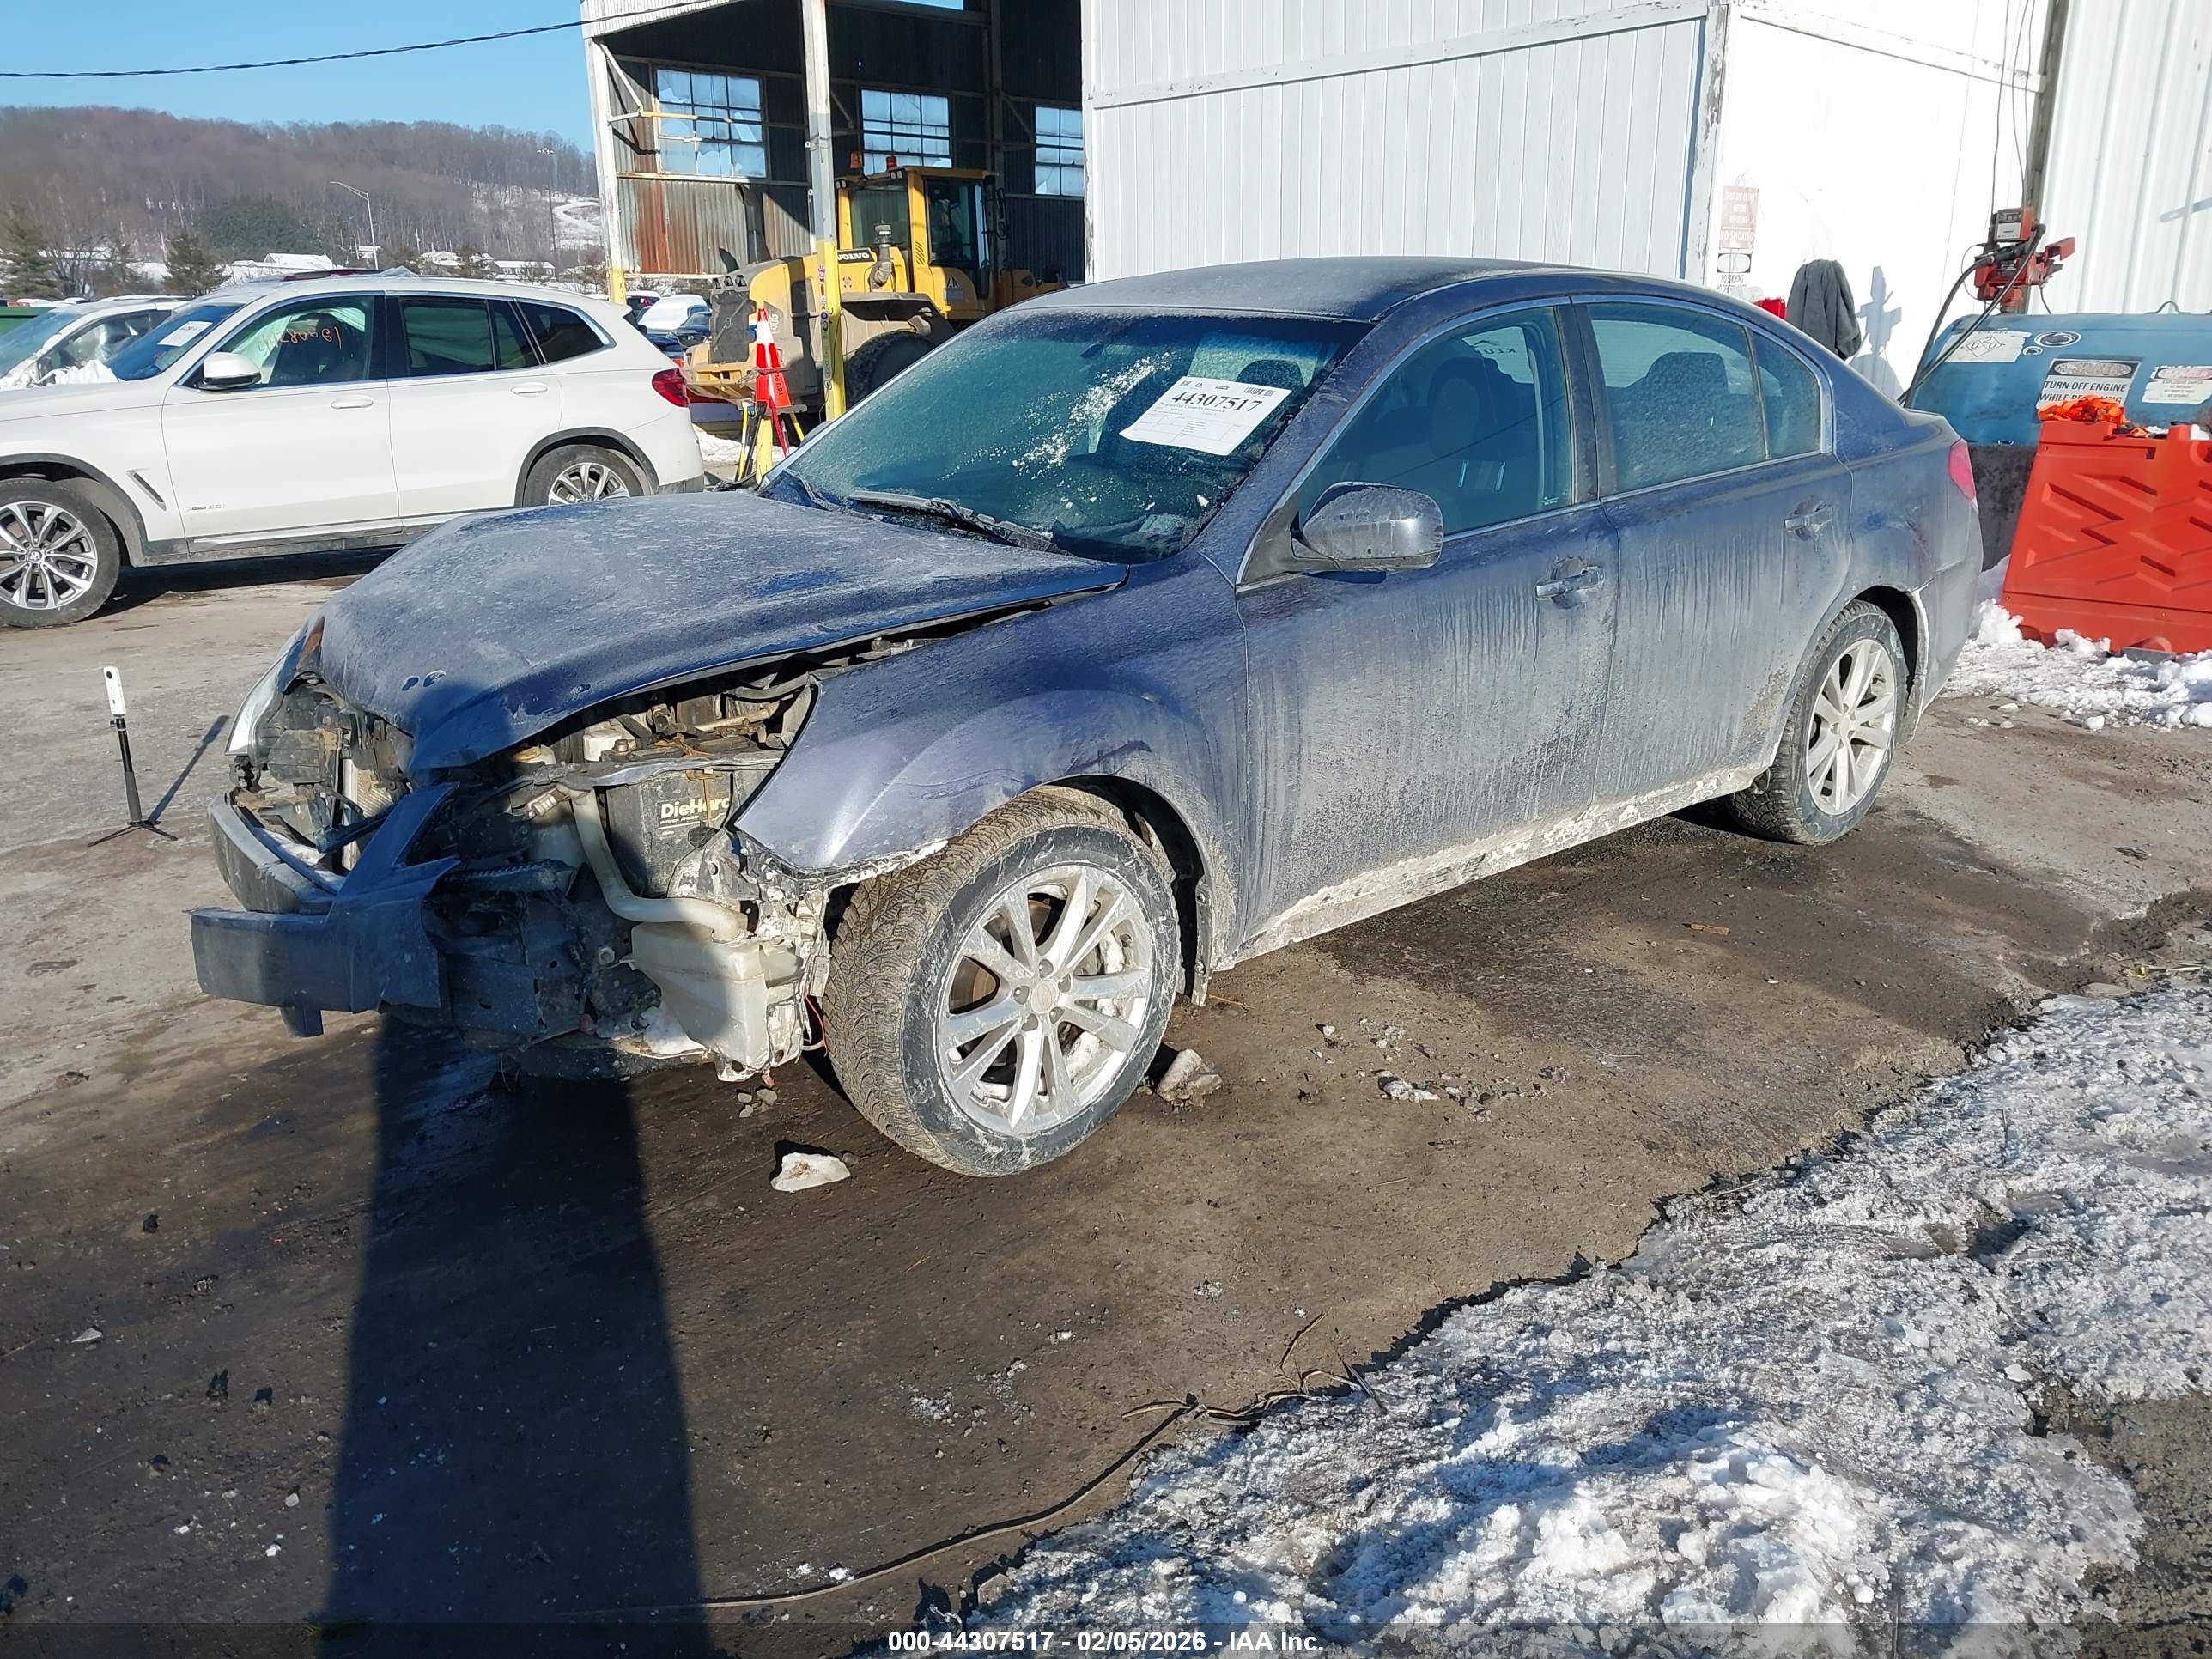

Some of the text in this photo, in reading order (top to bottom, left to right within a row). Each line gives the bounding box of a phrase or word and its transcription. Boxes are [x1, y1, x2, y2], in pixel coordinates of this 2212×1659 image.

[837, 252, 870, 261] VOLVO
[2045, 380, 2128, 392] TURN OFF ENGINE
[1172, 392, 1262, 411] 44307517
[2039, 392, 2069, 401] WHILE
